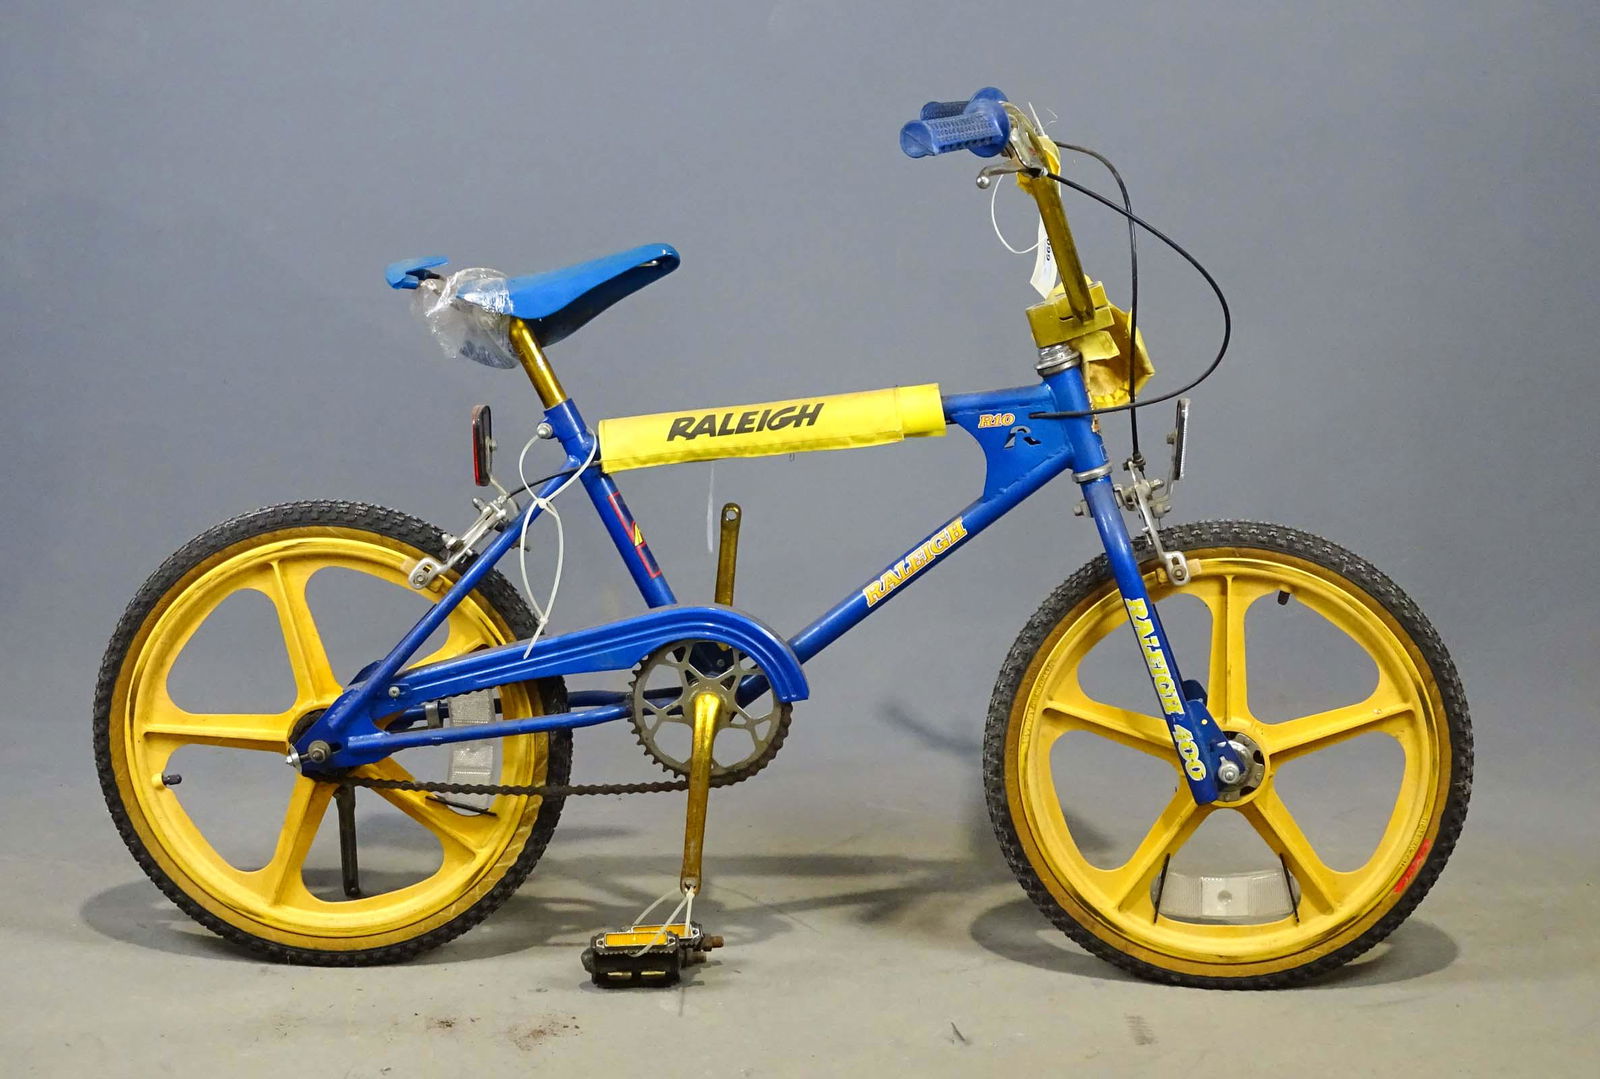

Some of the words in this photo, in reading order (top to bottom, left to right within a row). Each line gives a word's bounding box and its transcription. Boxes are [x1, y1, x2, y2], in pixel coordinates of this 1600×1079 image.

[666, 402, 825, 442] RALEIGH
[978, 412, 1016, 429] R10
[862, 516, 968, 608] RALEIGH
[1124, 597, 1186, 715] RALEIGH
[1172, 724, 1207, 782] 400
